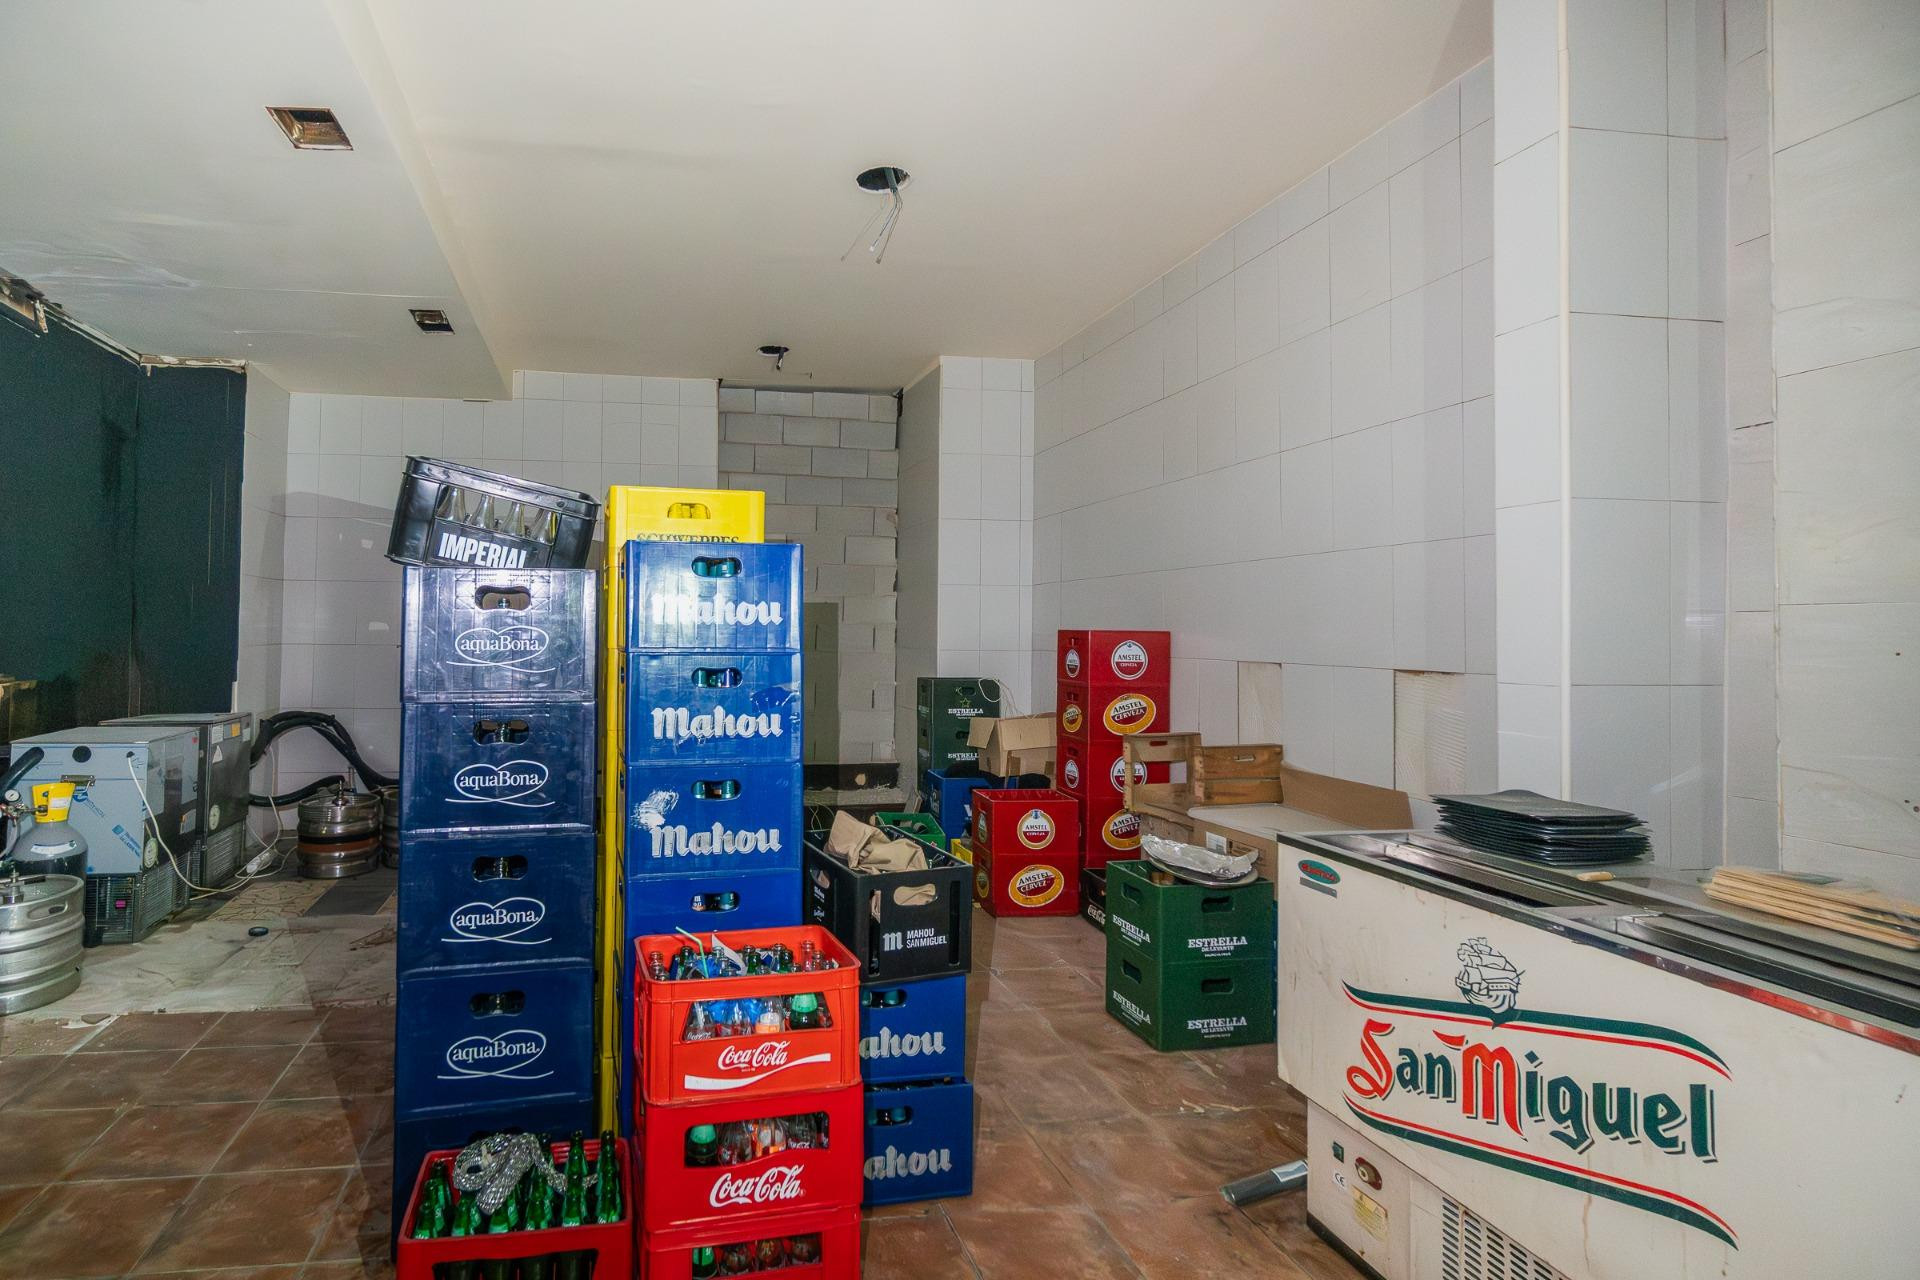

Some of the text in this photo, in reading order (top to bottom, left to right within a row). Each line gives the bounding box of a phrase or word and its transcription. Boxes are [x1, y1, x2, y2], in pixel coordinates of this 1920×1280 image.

[651, 592, 783, 626] Mahou
[461, 635, 540, 653] aquaBona
[1113, 700, 1143, 714] AMSTEL
[1114, 708, 1145, 721] CERVEZA
[651, 705, 783, 739] Mahou
[460, 769, 539, 787] aquaBona
[650, 822, 782, 858] Mahou
[1113, 823, 1138, 836] CERVEZ
[1018, 871, 1049, 886] AMSTEL
[455, 908, 539, 928] aquaBona
[1113, 914, 1151, 943] ESTRELLA
[907, 928, 934, 939] MAHOU
[1188, 936, 1248, 948] ESTRELLA
[1113, 990, 1151, 1025] ESTRELLA
[1187, 1016, 1247, 1029] ESTRELLA
[452, 1042, 540, 1064] aquaBona
[859, 1026, 946, 1059] ahou
[718, 1040, 791, 1071] Coca-Cola
[864, 1145, 952, 1180] ahou
[710, 1164, 804, 1208] Coca-Cola
